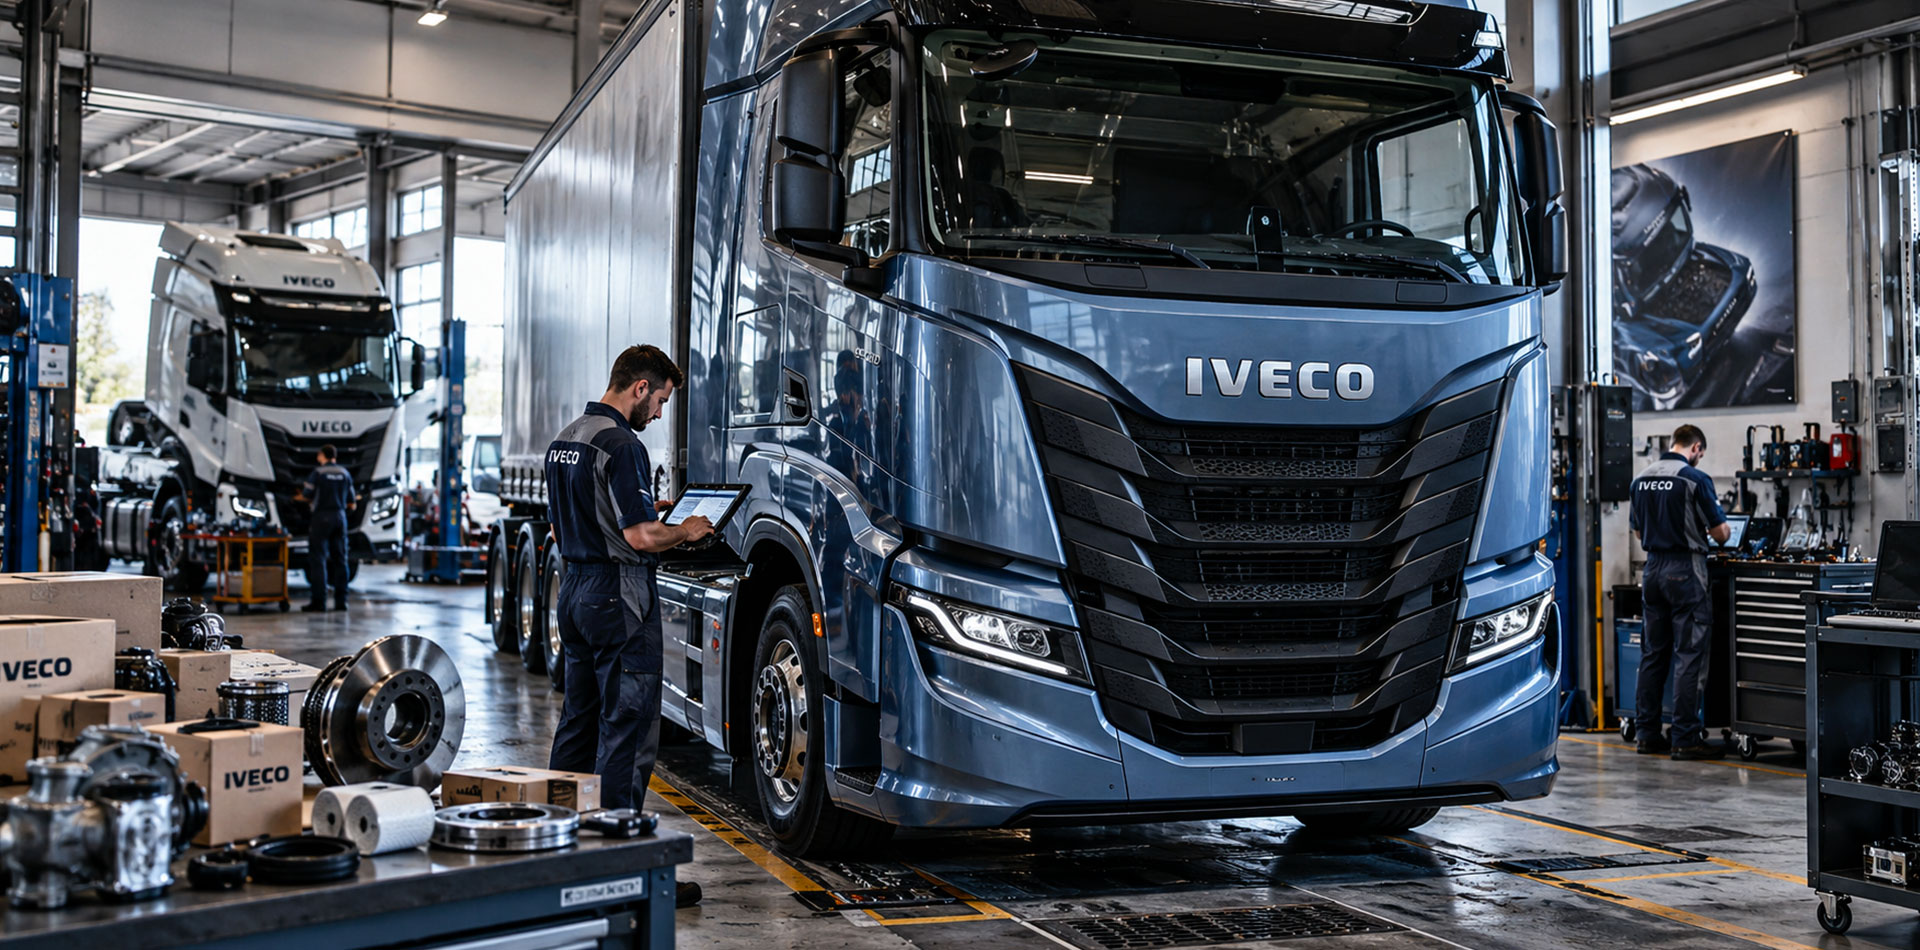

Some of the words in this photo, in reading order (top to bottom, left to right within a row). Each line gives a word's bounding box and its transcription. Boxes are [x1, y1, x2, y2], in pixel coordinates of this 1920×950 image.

[283, 274, 336, 289] IVECO
[1186, 357, 1375, 400] IVECO
[302, 421, 352, 433] IVECO
[548, 449, 580, 465] IVECO
[1638, 480, 1674, 491] IVECO
[0, 657, 72, 681] VECO
[224, 765, 290, 790] IVECO
